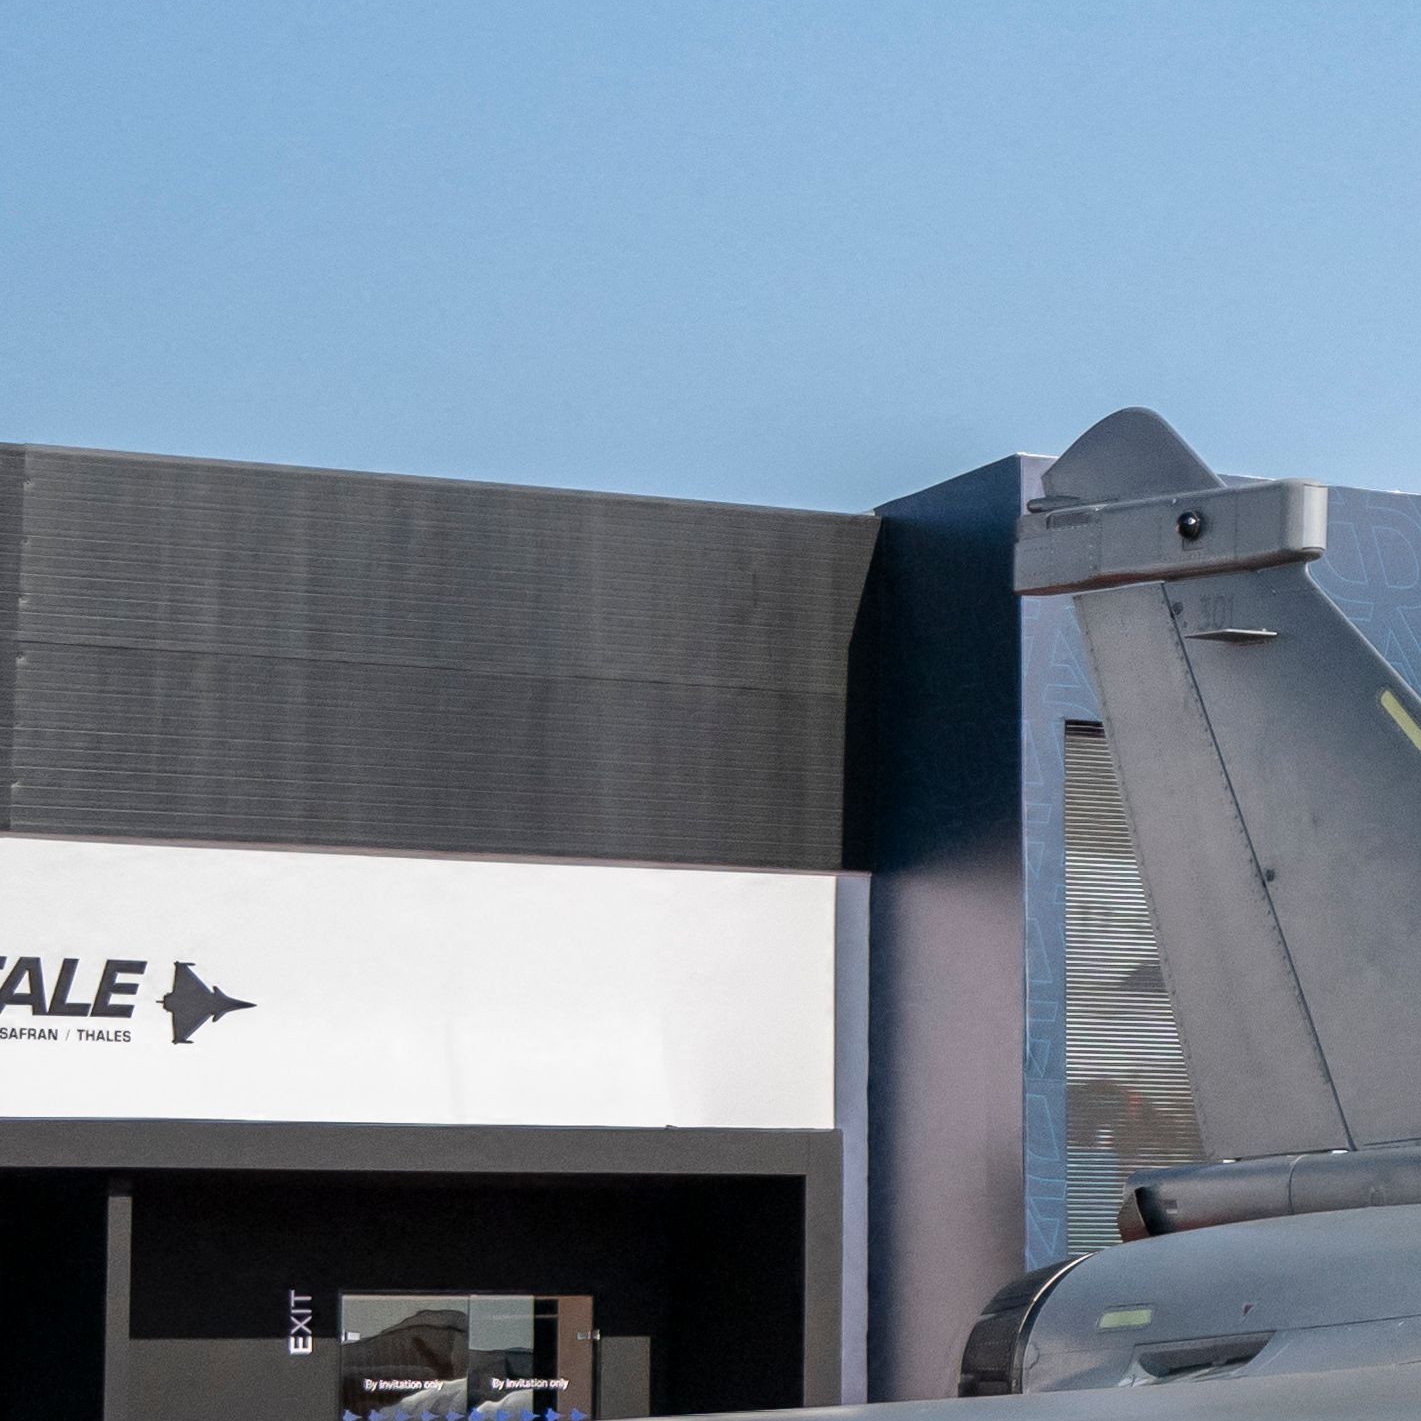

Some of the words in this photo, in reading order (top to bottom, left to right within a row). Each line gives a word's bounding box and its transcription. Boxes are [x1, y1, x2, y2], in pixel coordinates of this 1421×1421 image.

[0, 956, 148, 1018] ALE
[0, 1027, 58, 1041] SAFRAN
[77, 1029, 131, 1042] THALES
[289, 1289, 312, 1355] EXIT
[365, 1379, 378, 1392] By
[379, 1379, 422, 1390] invitation
[423, 1379, 444, 1391] only
[492, 1378, 504, 1390] By
[505, 1378, 548, 1389] invitation
[549, 1378, 569, 1391] only
